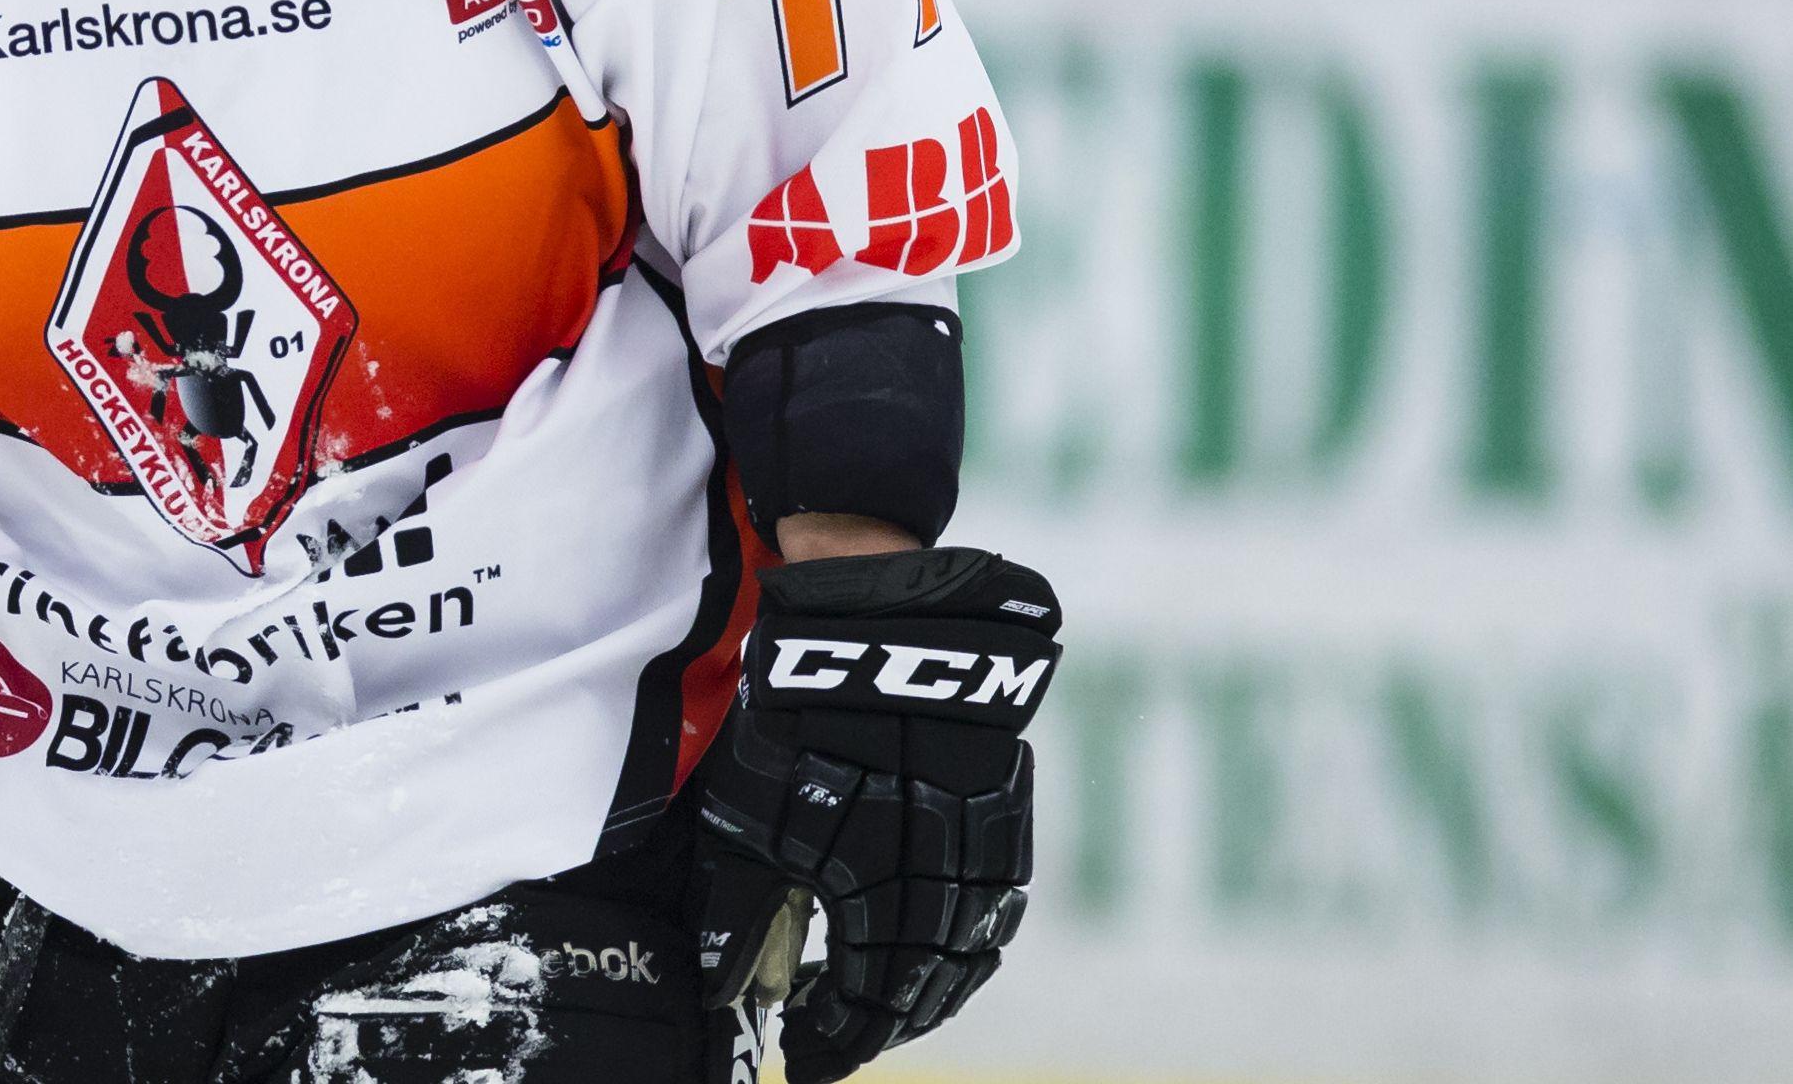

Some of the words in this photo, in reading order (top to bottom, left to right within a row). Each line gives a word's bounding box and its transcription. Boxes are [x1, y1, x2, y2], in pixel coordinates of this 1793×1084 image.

[181, 129, 342, 322] KARLSKRONA
[746, 105, 1015, 286] ABB
[269, 330, 306, 359] 01
[767, 638, 1051, 707] CCM
[539, 940, 662, 985] ebok
